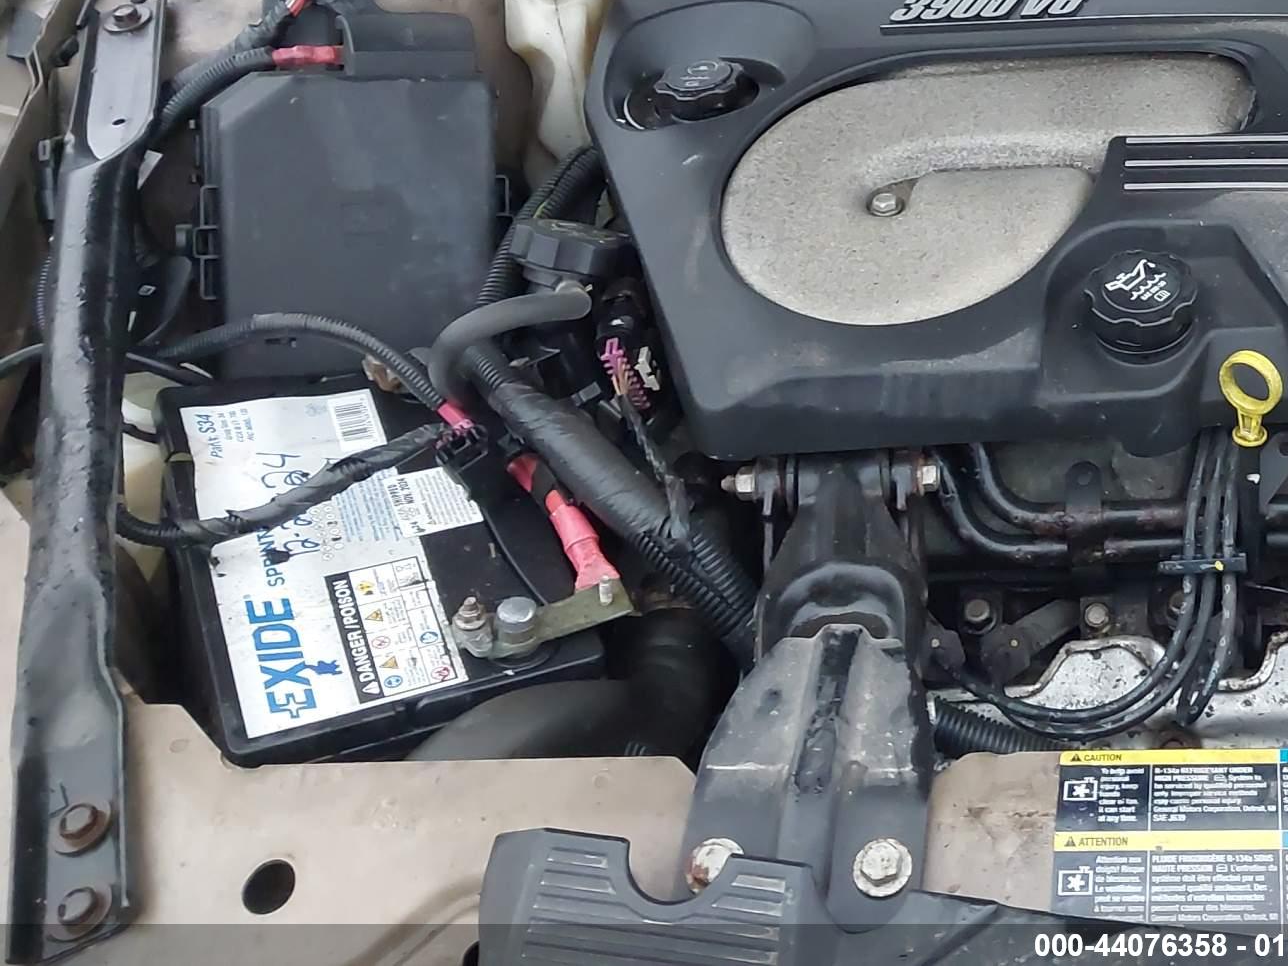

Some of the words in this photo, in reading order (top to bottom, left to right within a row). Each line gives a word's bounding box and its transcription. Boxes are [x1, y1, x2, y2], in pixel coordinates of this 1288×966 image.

[195, 413, 216, 433] S34
[245, 598, 317, 718] EXIDE
[1078, 837, 1128, 846] ATTENTION
